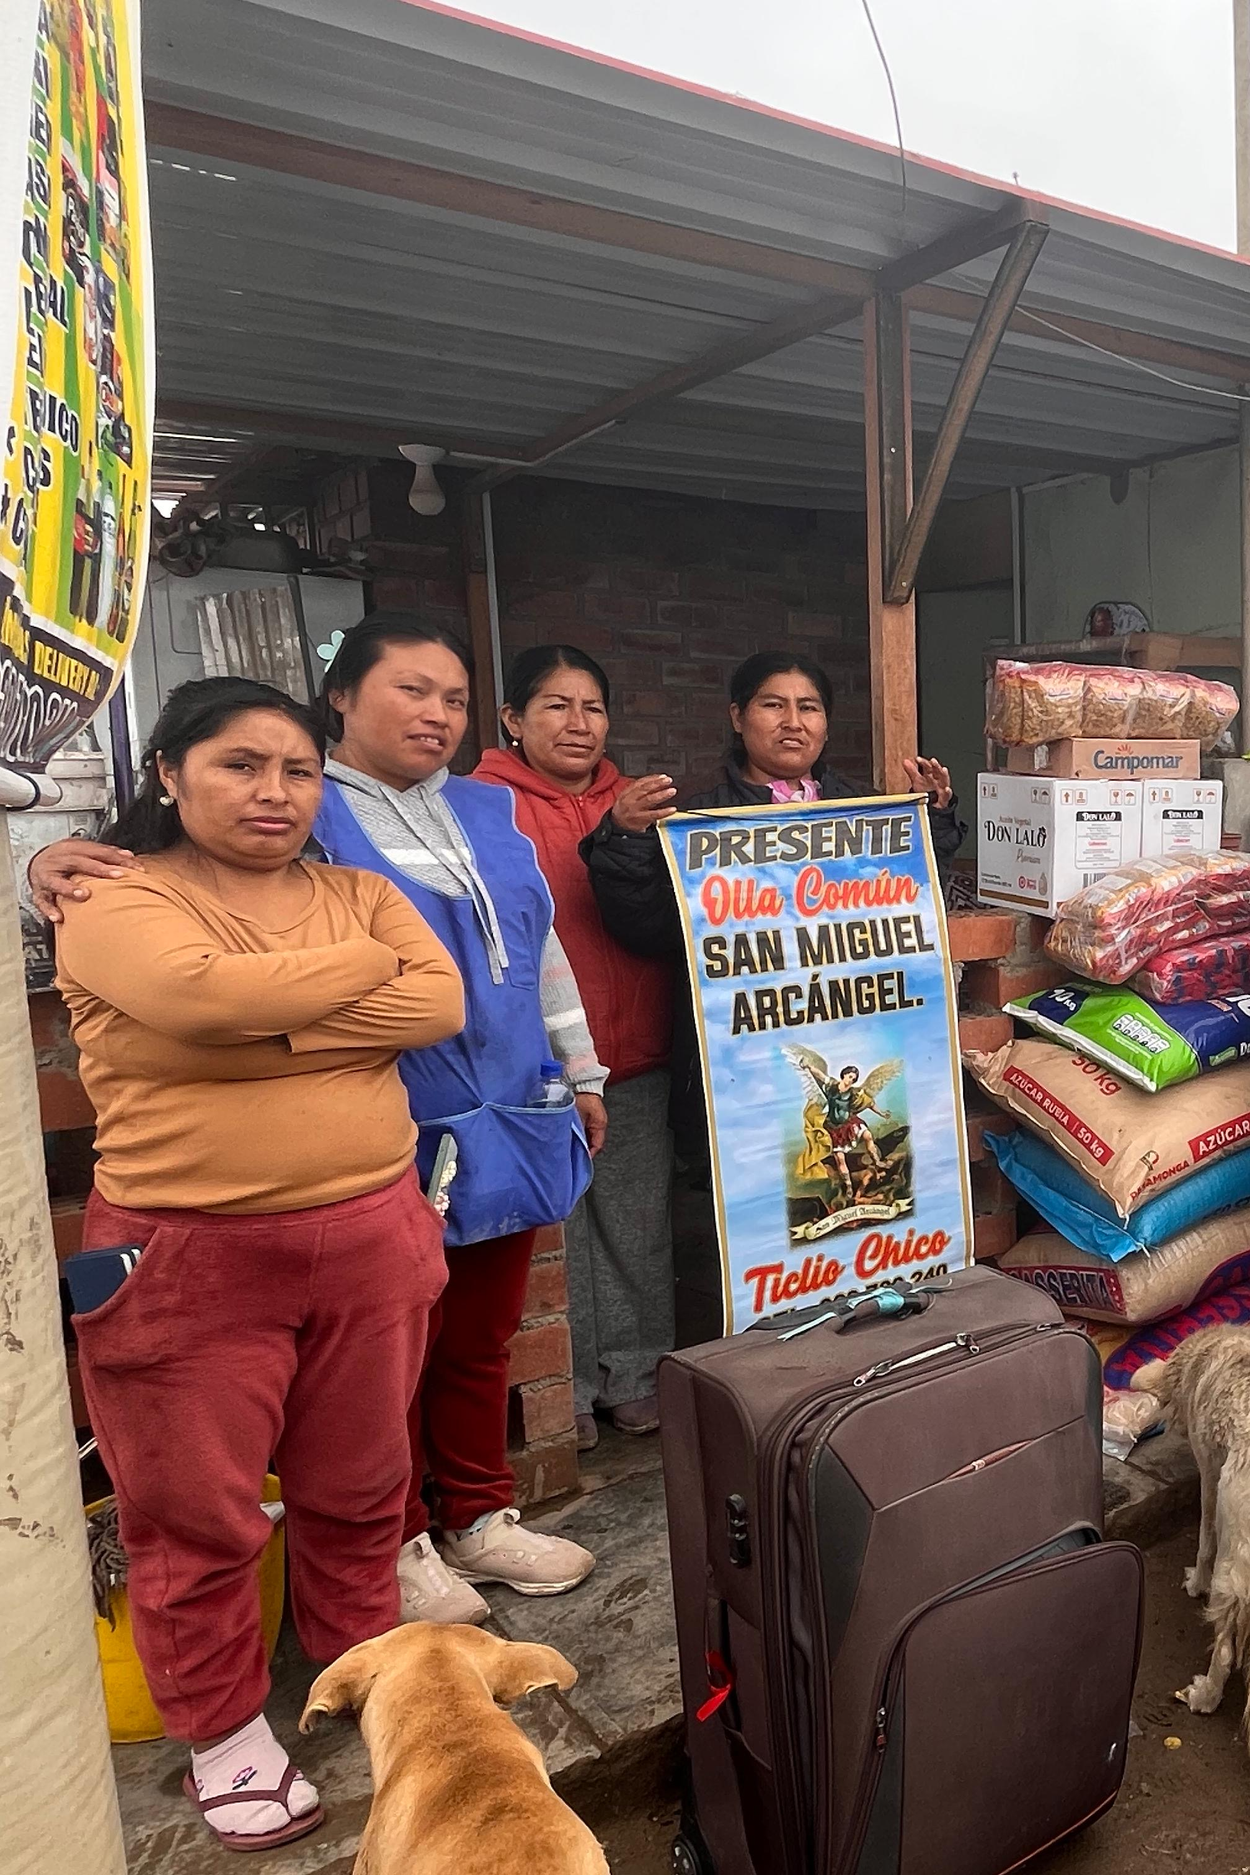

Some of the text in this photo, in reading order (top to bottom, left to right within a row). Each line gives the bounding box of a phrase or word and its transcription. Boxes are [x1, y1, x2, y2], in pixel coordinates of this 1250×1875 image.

[1093, 750, 1183, 775] Campomar
[687, 815, 914, 871] PRESENTE
[702, 865, 919, 927] Olla Común
[702, 914, 935, 979] SAN MIGUEL
[731, 971, 925, 1035] ARCÁNGEL.
[1094, 1071, 1122, 1096] kg
[1042, 1098, 1070, 1126] RUBIA
[1077, 1127, 1092, 1144] 50
[1090, 1139, 1105, 1158] kg
[1199, 1120, 1250, 1156] AZÚCAR
[744, 1227, 952, 1314] Ticlio Chico
